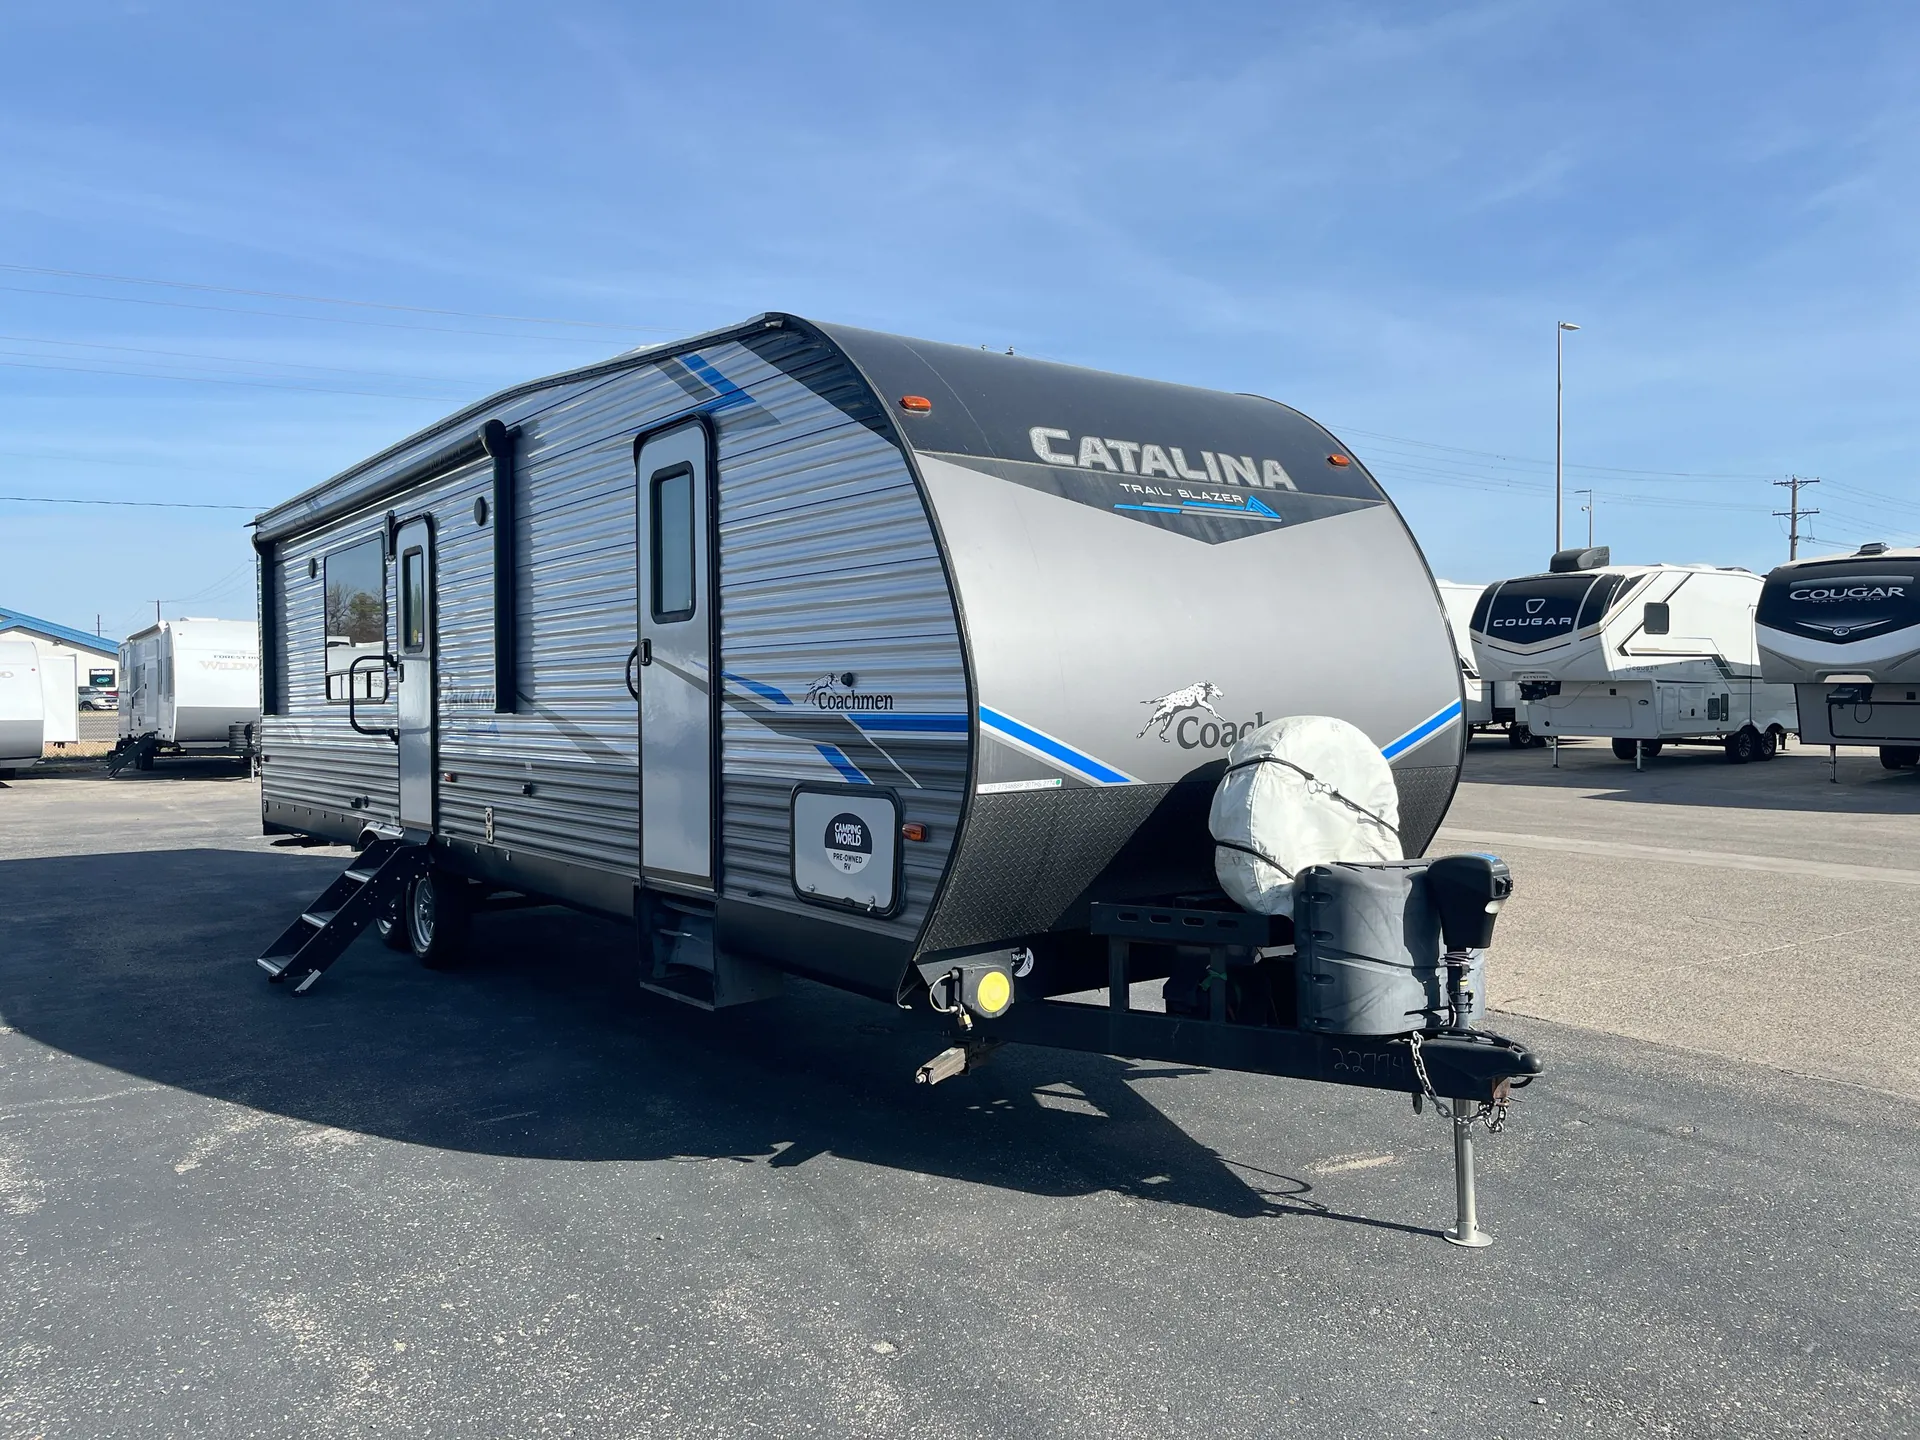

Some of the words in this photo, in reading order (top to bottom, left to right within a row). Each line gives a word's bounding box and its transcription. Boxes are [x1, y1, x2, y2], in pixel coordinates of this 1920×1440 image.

[1029, 426, 1299, 492] CATALINA
[1119, 483, 1172, 497] TRAIL
[1177, 488, 1245, 504] BLAZER
[1789, 587, 1905, 600] COUGAR
[1493, 617, 1572, 627] COUGAR
[818, 689, 894, 710] Coachmen
[834, 822, 862, 835] CAMPING
[834, 832, 862, 847] WORLD
[832, 852, 863, 864] PRE-OWNED
[843, 862, 852, 871] RV
